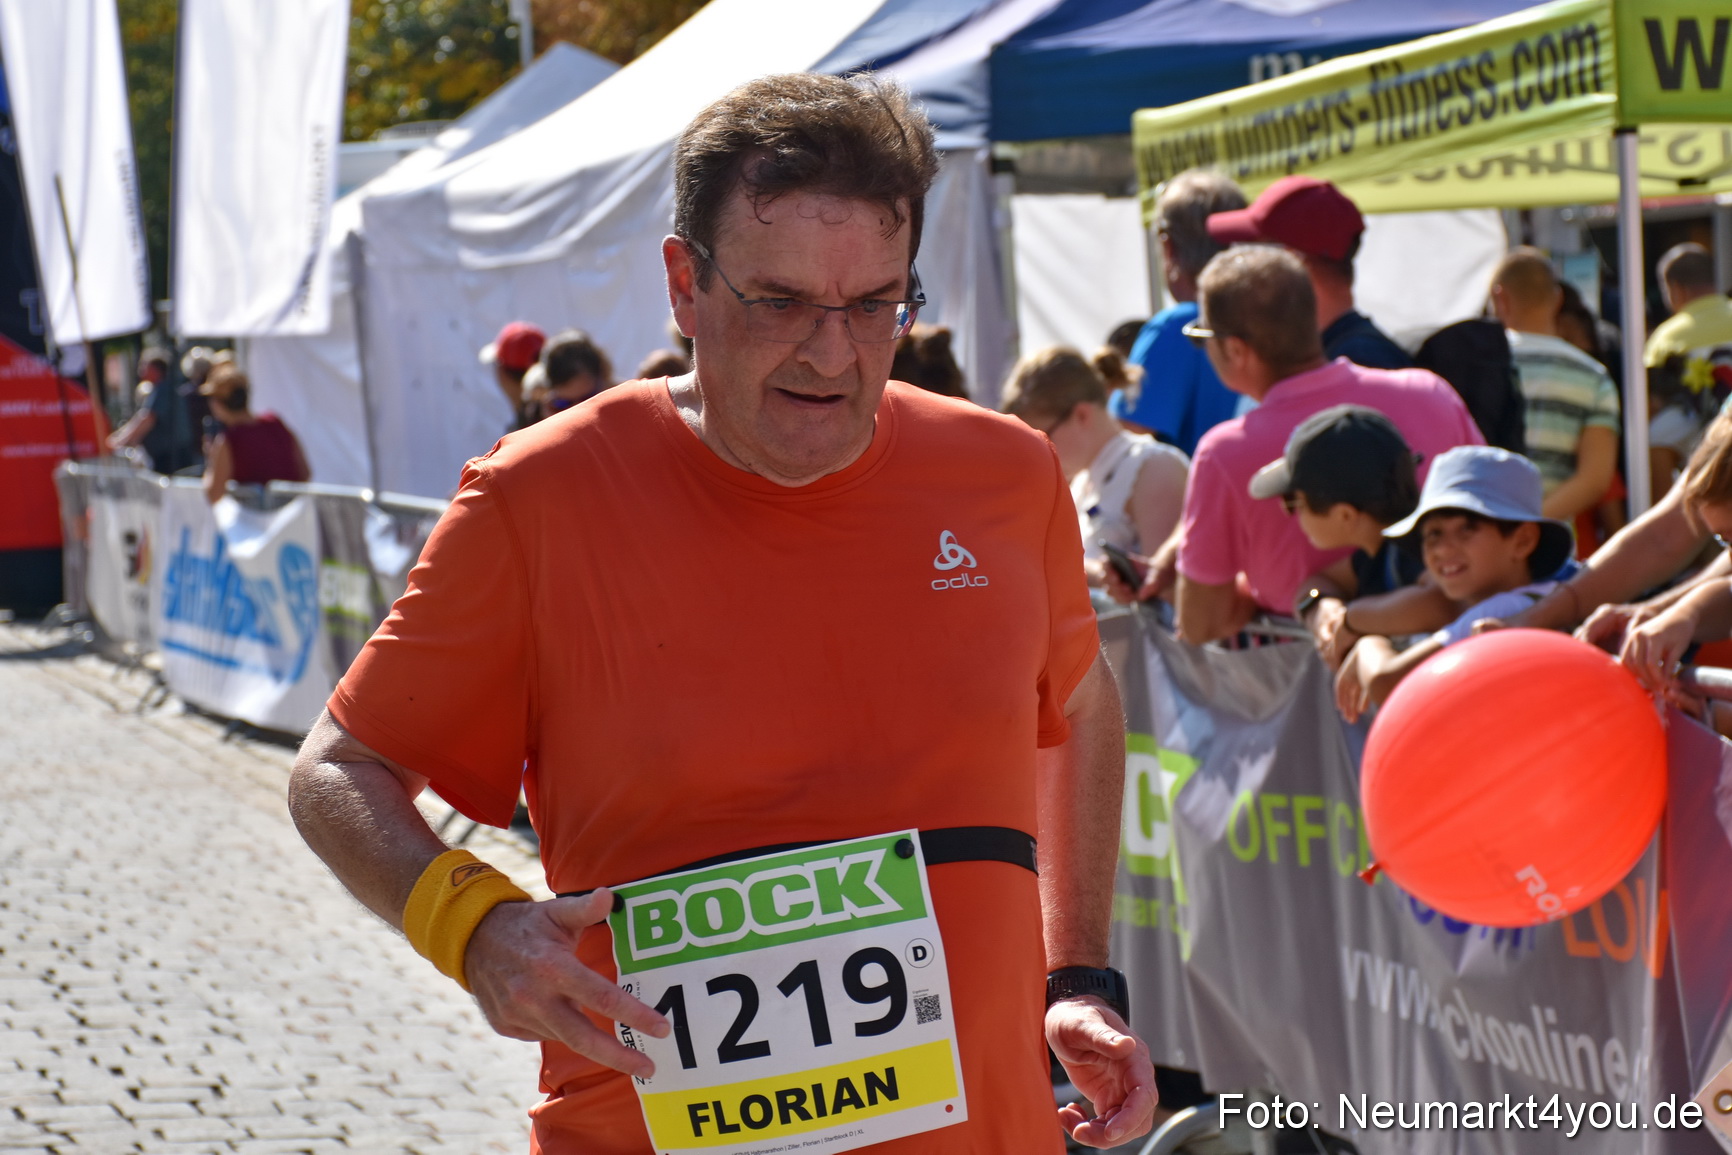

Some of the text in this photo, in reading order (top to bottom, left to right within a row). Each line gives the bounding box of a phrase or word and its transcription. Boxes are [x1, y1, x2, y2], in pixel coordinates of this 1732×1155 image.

[931, 573, 989, 590] odlo
[625, 848, 904, 961] BOCK
[912, 945, 927, 962] D
[653, 946, 908, 1070] 1219
[687, 1066, 900, 1138] FLORIAN
[823, 1132, 848, 1143] Startblock
